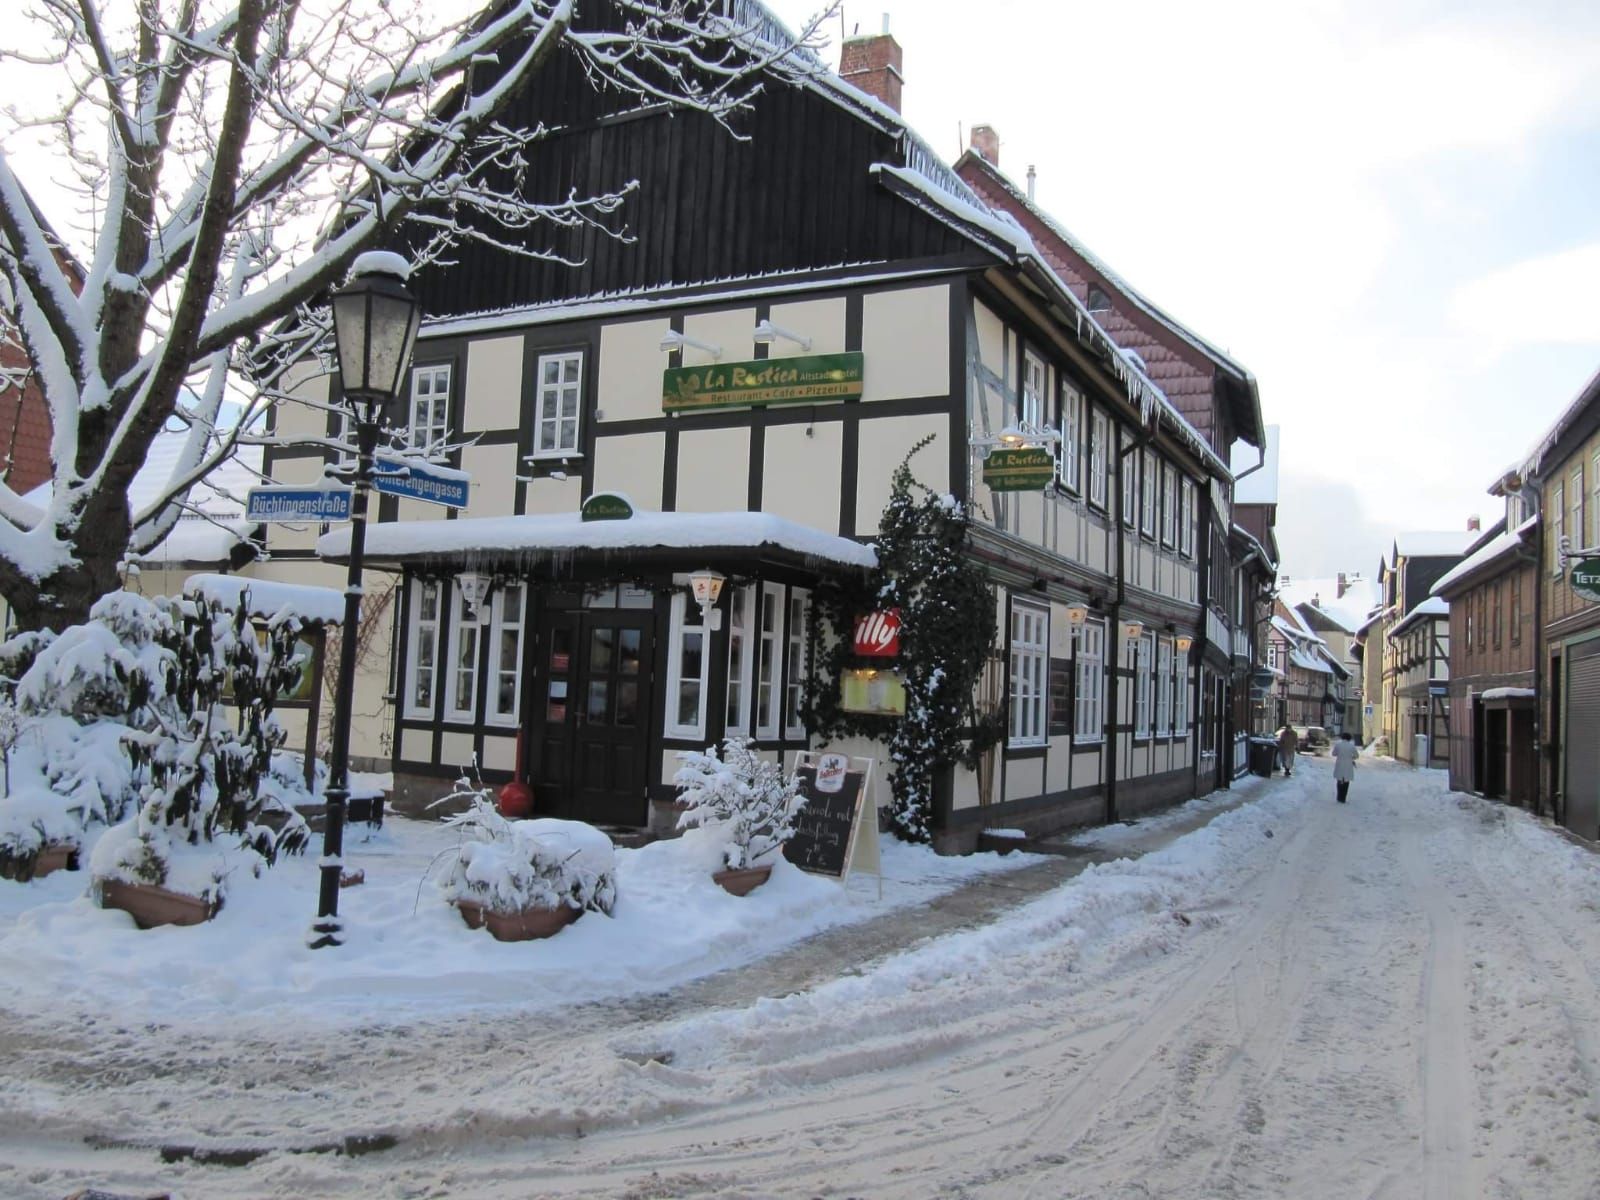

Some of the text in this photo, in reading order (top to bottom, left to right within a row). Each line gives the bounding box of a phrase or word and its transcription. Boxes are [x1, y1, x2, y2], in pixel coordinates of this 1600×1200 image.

[704, 369, 725, 389] La
[711, 387, 763, 403] Restaurant
[806, 384, 849, 396] Pizzeria
[252, 494, 347, 514] Büchtingenstraße
[855, 612, 896, 652] illy
